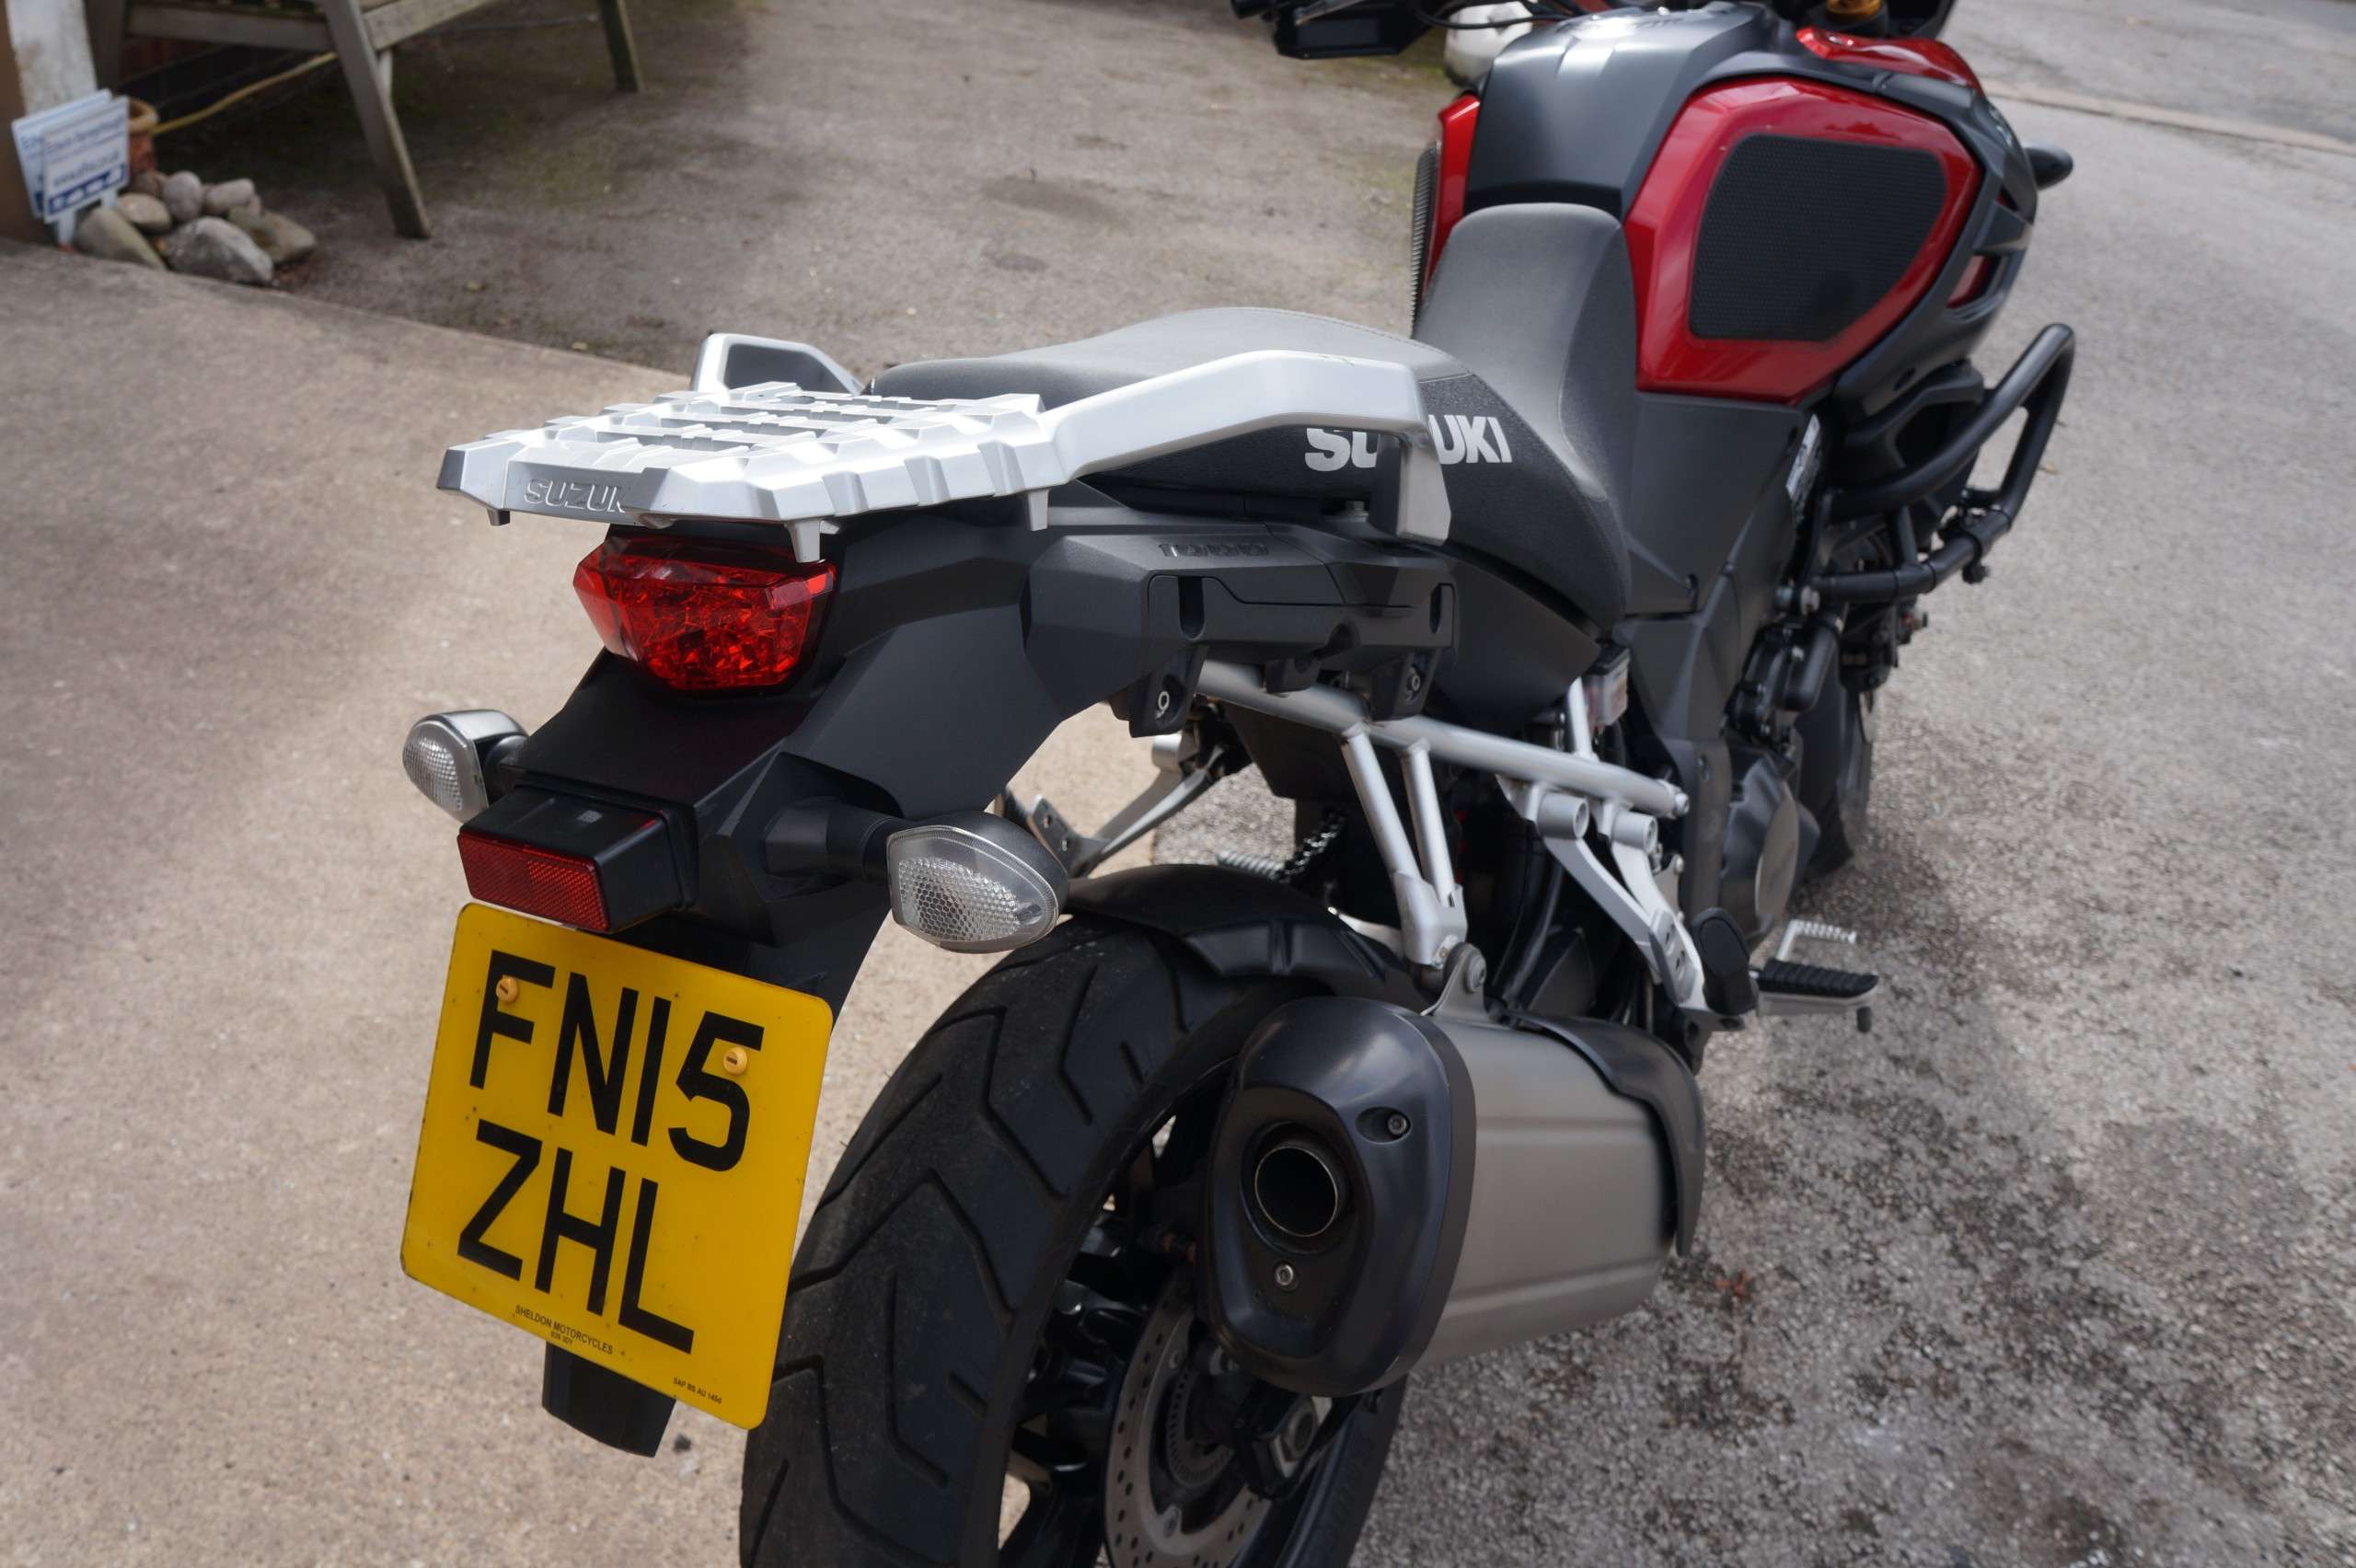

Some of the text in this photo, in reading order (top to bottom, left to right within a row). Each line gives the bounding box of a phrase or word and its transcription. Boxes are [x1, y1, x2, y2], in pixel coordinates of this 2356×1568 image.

[1304, 414, 1513, 472] SUUKI
[524, 478, 628, 514] SUZUK
[469, 949, 765, 1172] FN15
[456, 1118, 695, 1355] ZHL
[514, 1304, 614, 1355] SHELDON MOTORCYCLES
